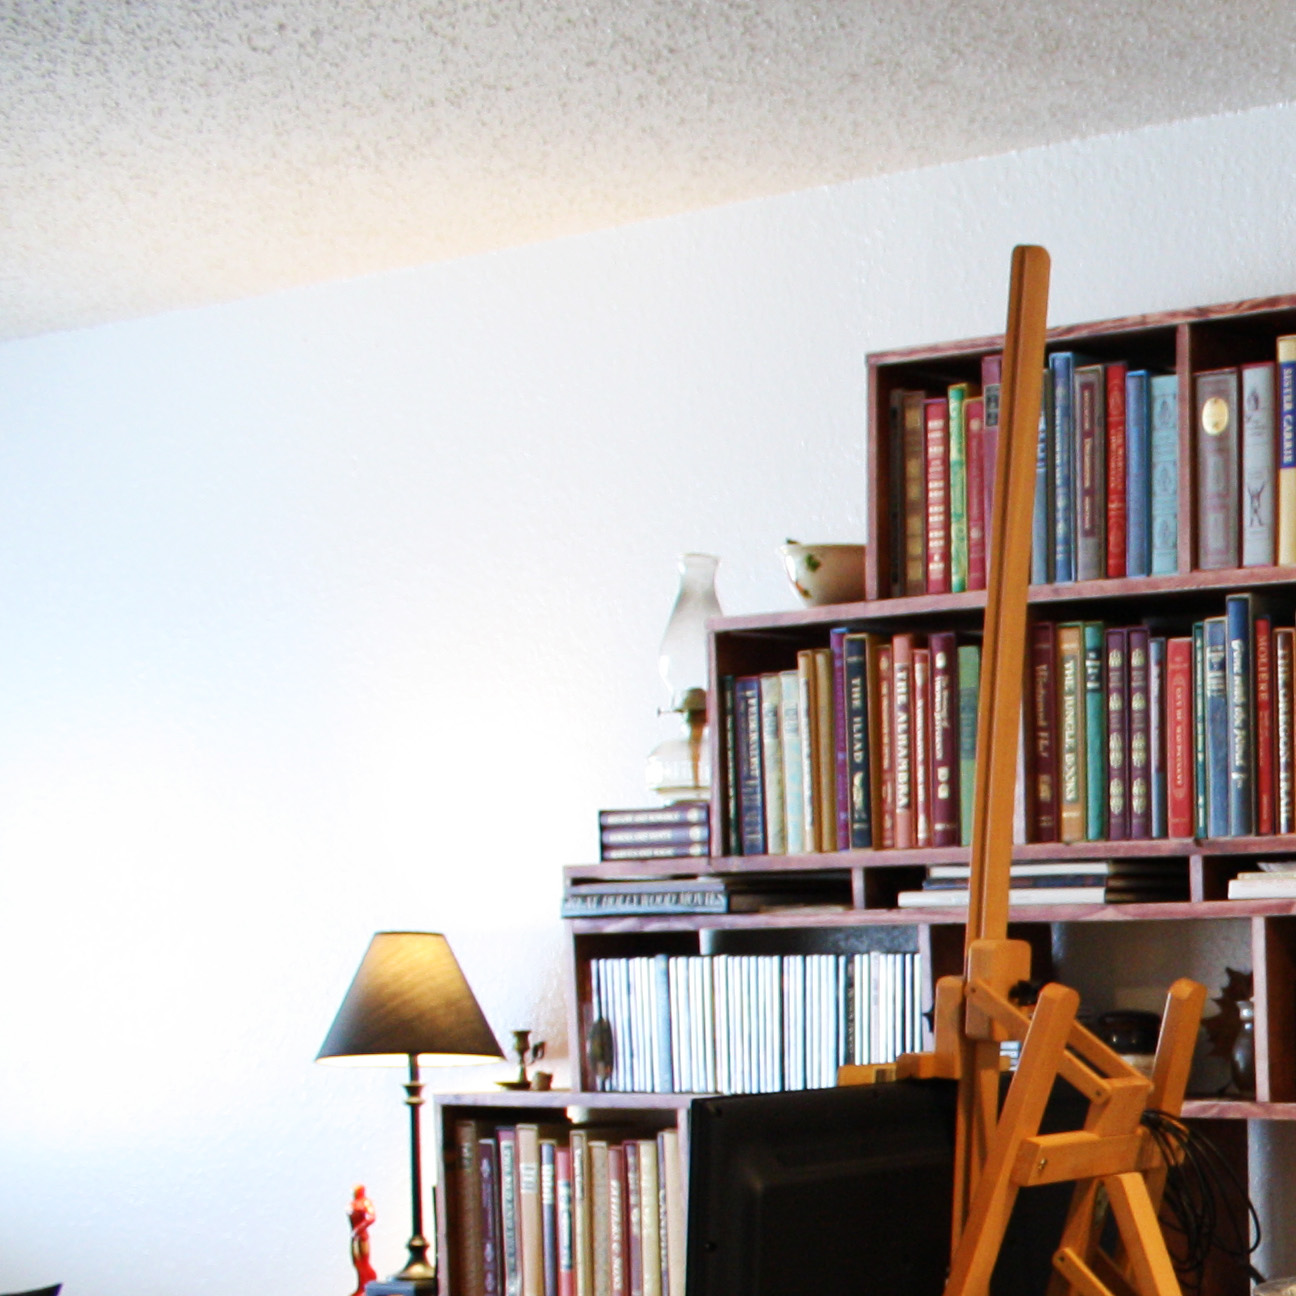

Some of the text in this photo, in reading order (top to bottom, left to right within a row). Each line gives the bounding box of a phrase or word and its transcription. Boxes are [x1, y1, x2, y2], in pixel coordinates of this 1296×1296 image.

[896, 670, 908, 704] THE
[1063, 660, 1075, 801] THE JUNGLE BOOKS
